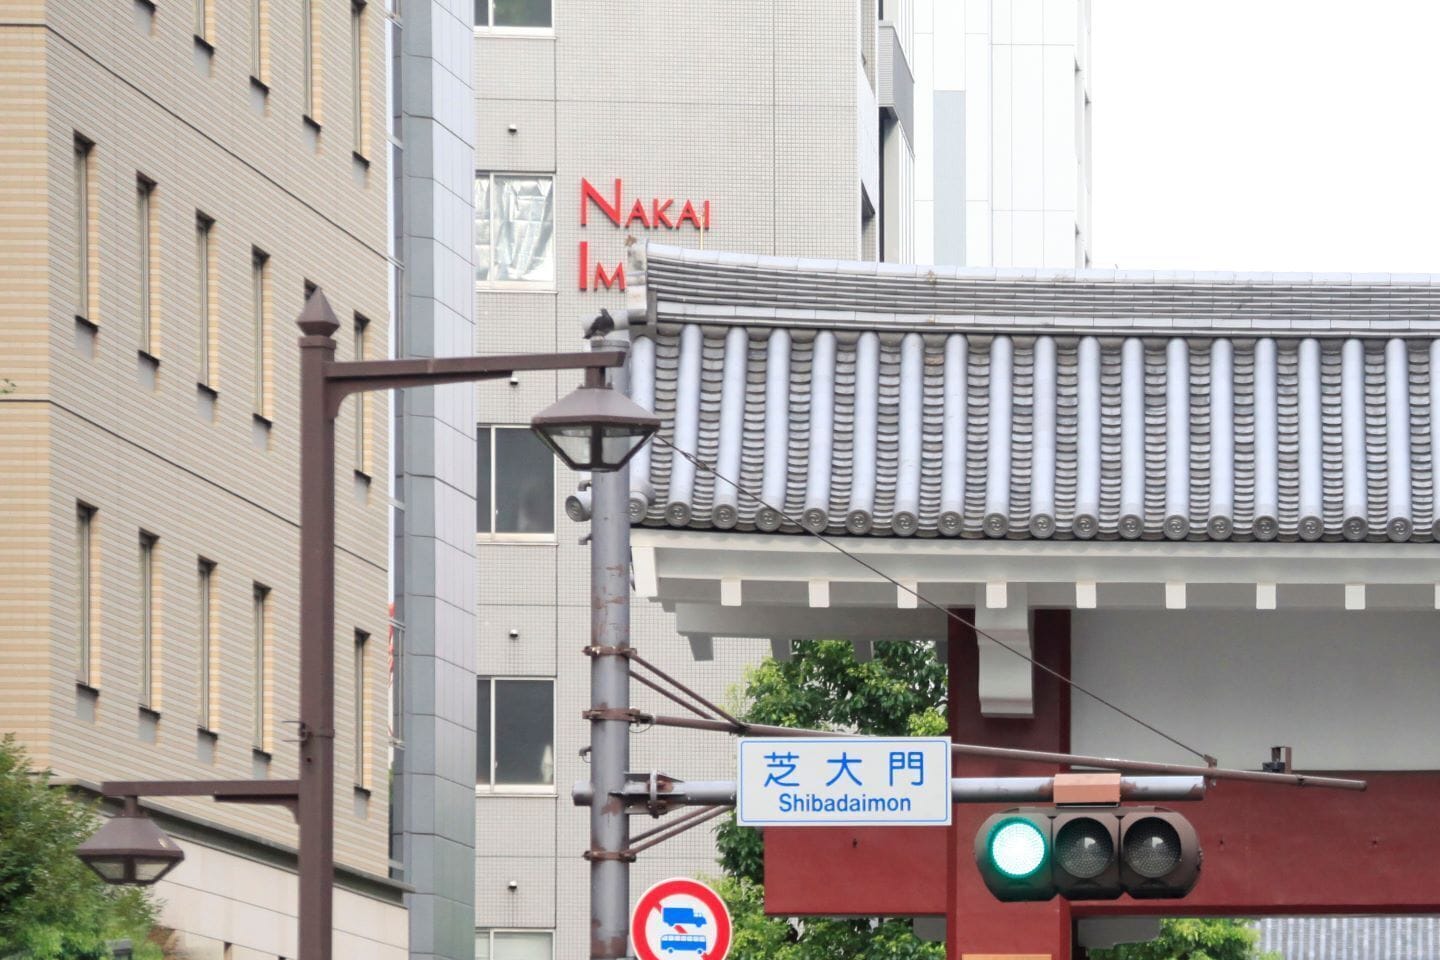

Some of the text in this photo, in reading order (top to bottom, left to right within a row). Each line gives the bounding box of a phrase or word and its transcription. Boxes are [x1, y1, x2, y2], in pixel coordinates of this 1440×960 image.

[581, 177, 710, 230] NAKAI
[763, 752, 925, 787] 芝大門
[778, 793, 912, 812] Shibadaimon
